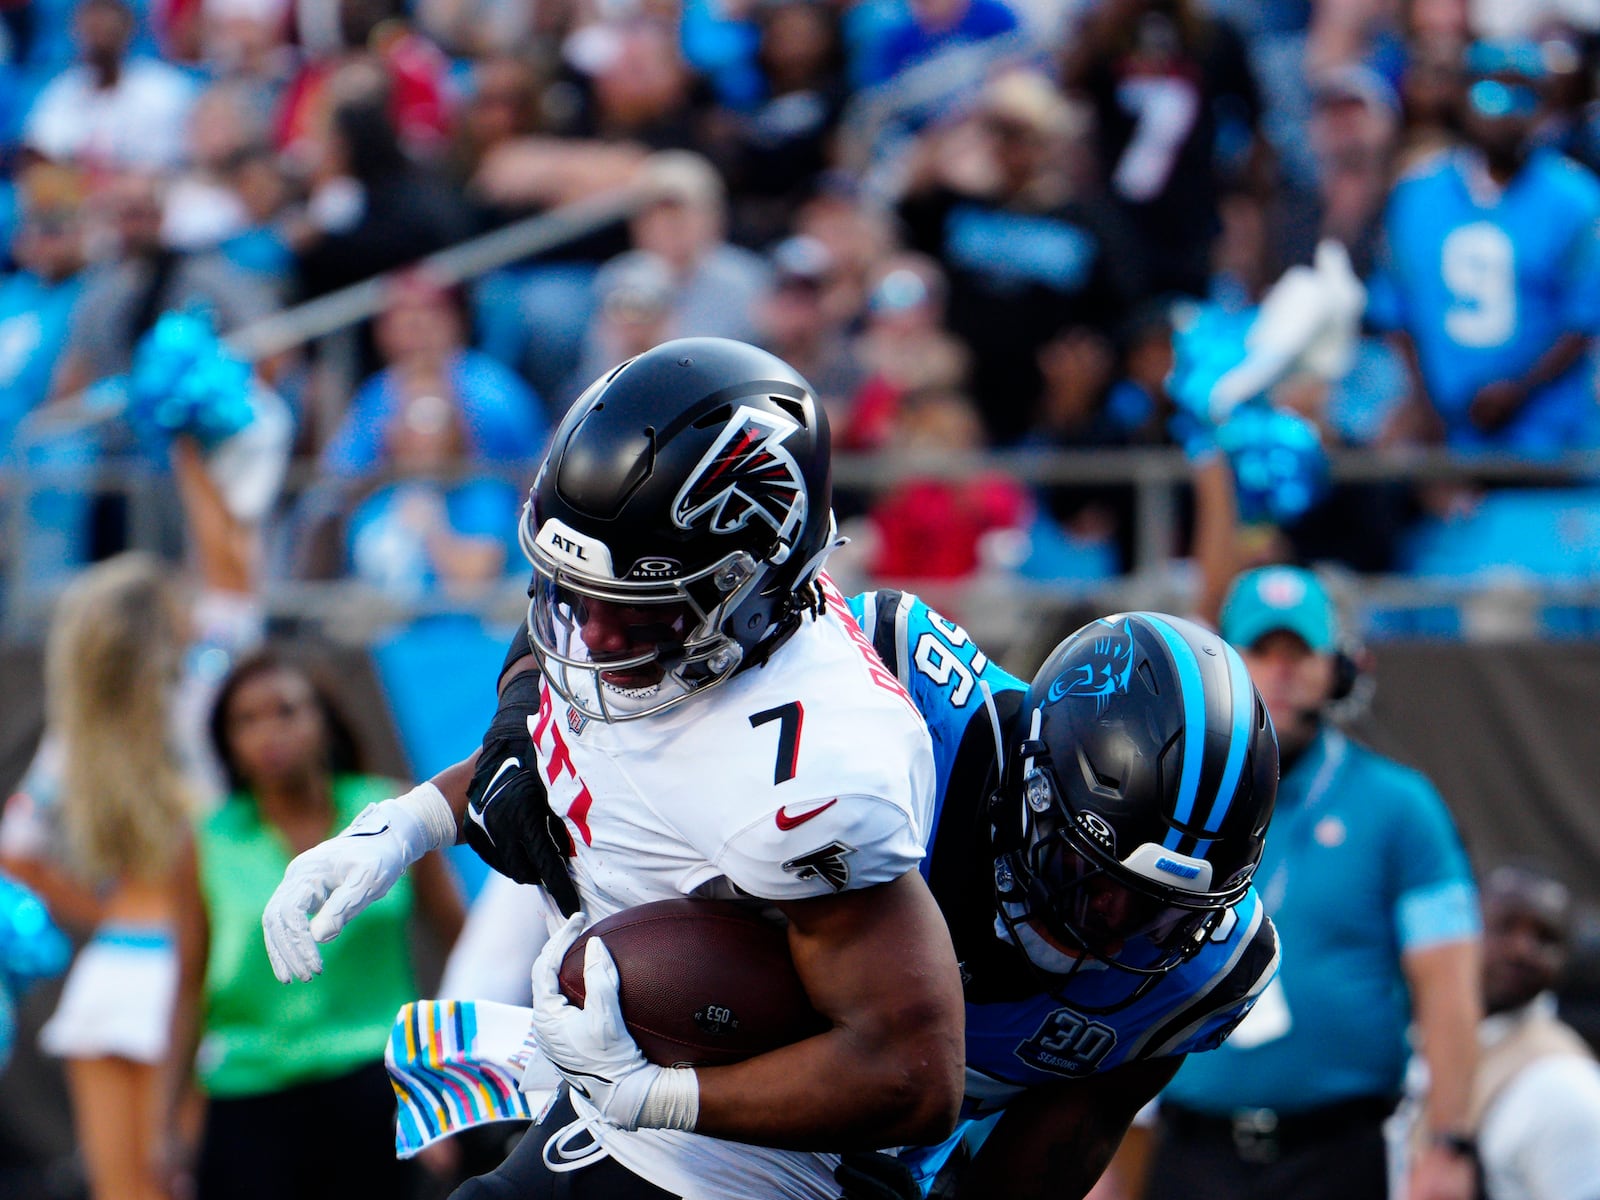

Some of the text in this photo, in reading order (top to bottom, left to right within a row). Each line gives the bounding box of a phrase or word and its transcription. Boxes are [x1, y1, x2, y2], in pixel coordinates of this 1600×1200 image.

[1113, 74, 1199, 202] 7
[1441, 220, 1517, 346] 9
[551, 532, 588, 561] ATL
[748, 700, 804, 786] 7
[1076, 815, 1113, 847] OAKLEY
[1036, 1051, 1079, 1071] SEASONS
[1039, 1011, 1112, 1061] 30
